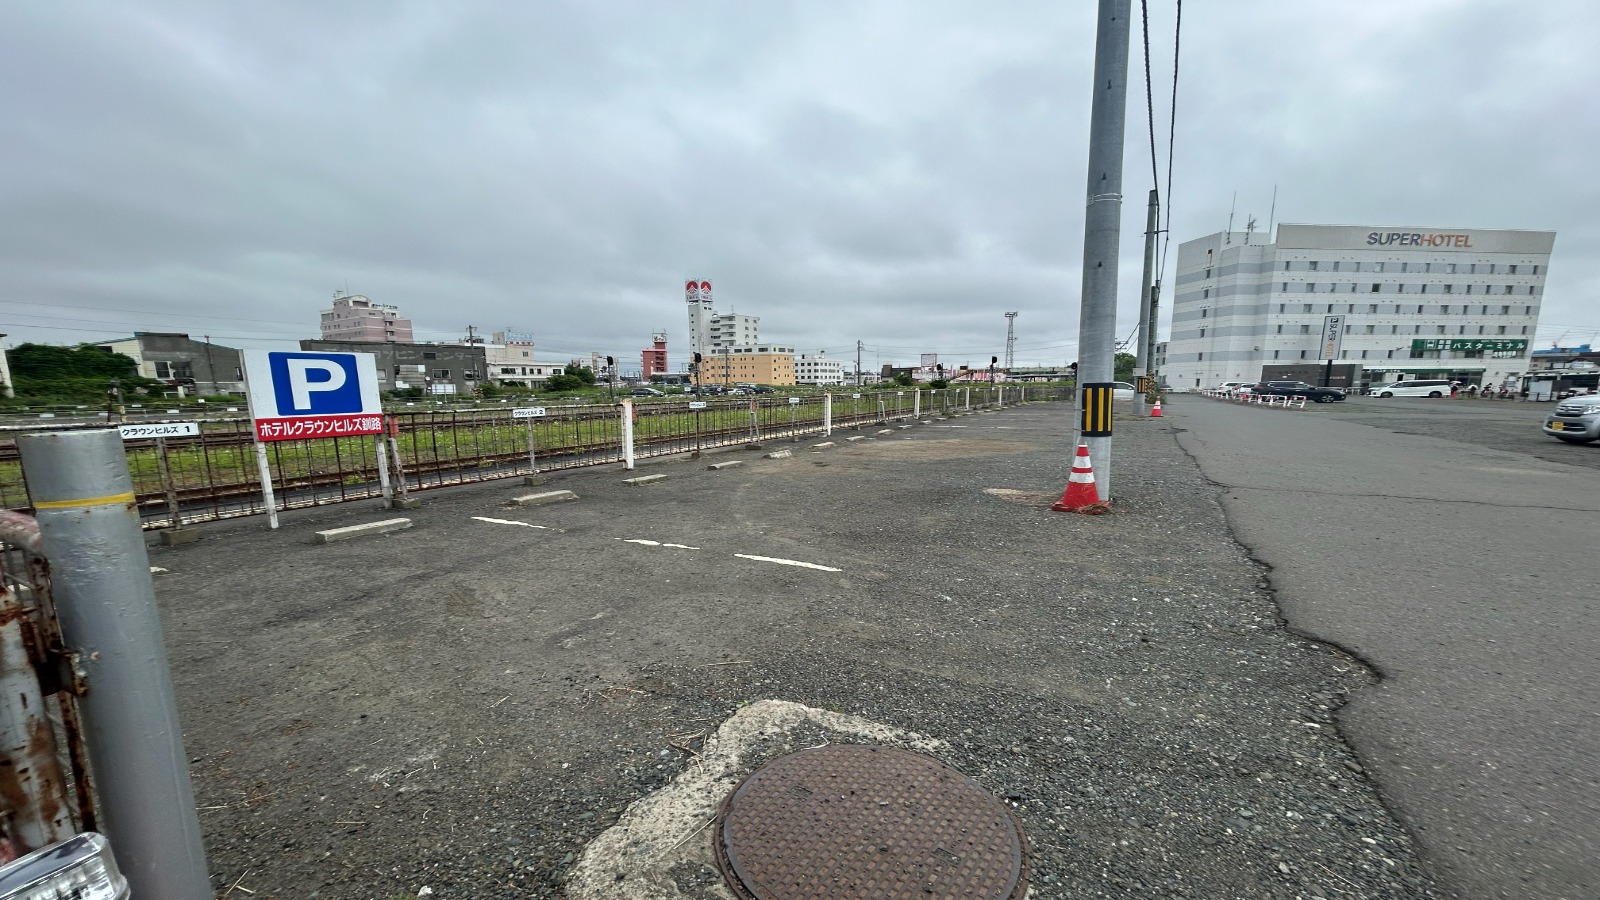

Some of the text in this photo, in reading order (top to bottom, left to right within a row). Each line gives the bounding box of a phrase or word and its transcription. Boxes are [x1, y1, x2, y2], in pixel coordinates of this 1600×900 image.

[287, 358, 347, 410] P
[122, 425, 191, 436] クラウンヒルズ 1
[259, 417, 382, 437] ホテルクラウンヒルズ釧路
